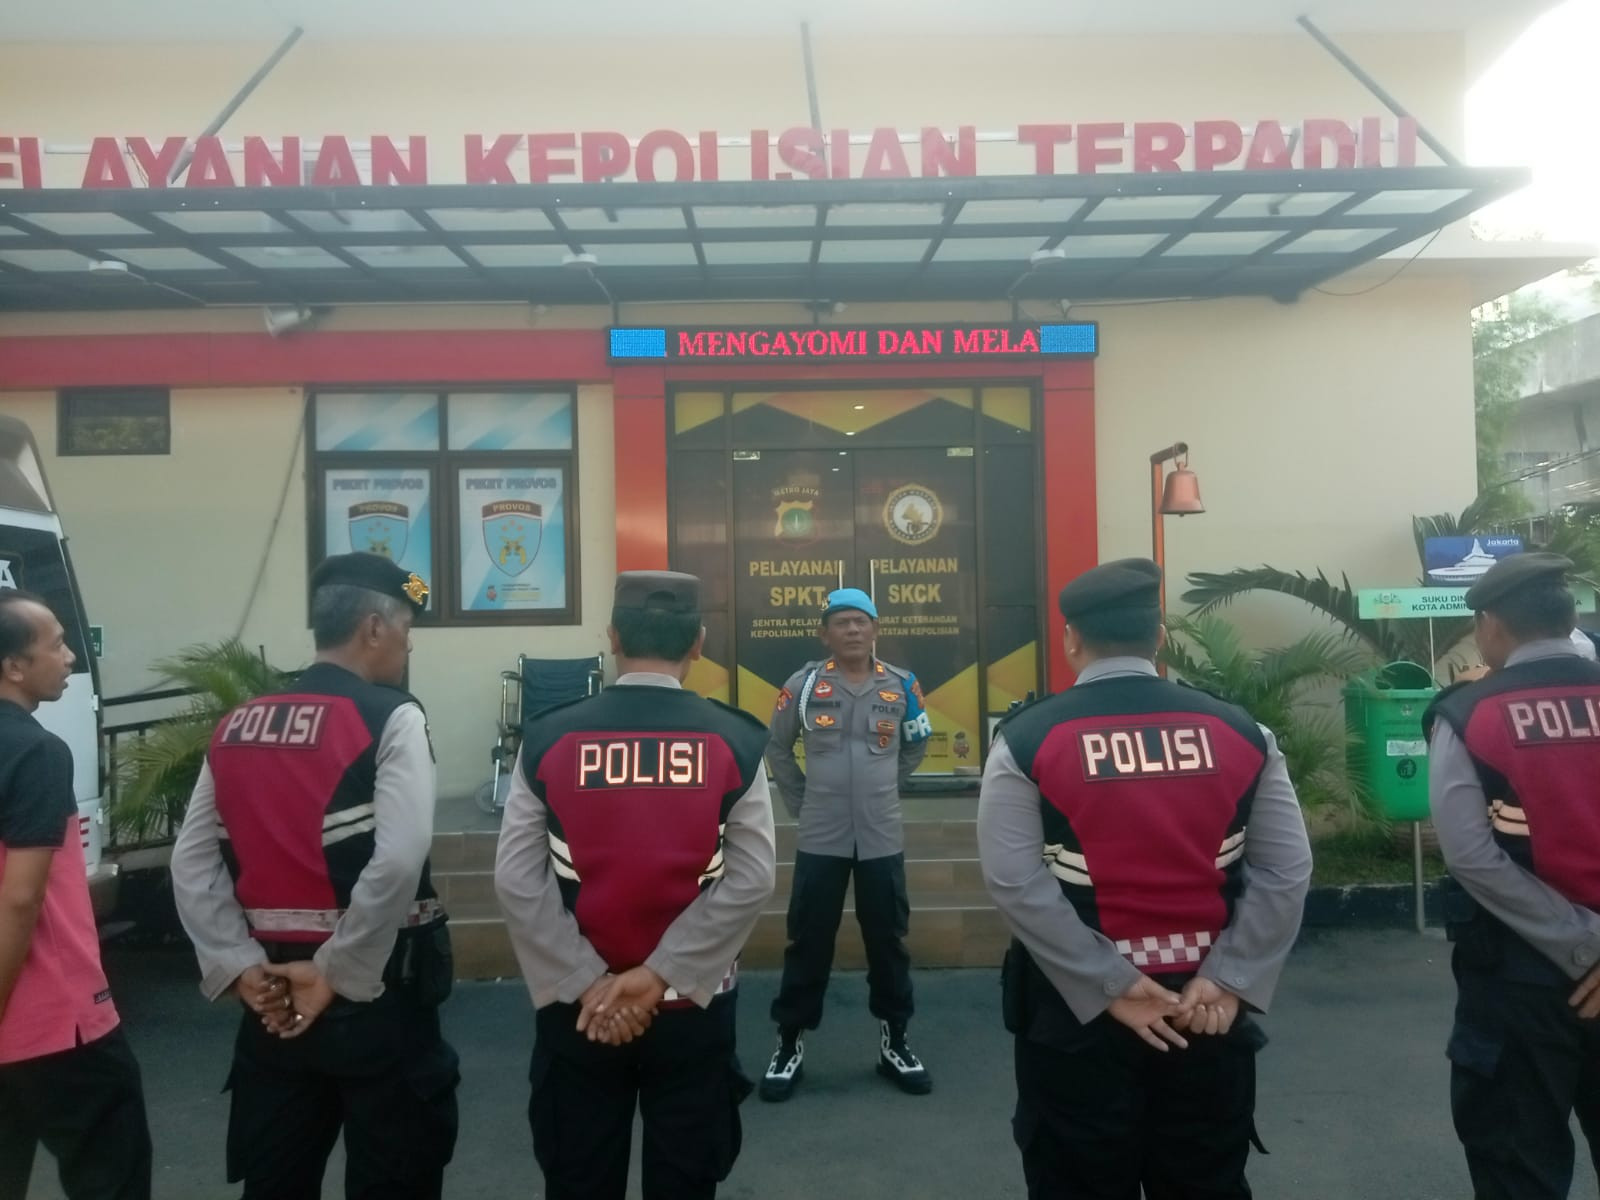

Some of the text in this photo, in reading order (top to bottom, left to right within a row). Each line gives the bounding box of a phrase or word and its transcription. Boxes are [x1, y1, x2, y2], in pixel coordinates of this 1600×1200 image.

[678, 328, 1041, 356] MENGAYOMI DAN MELA
[492, 502, 532, 513] PROVOS
[1487, 538, 1519, 546] Jakarta
[770, 585, 826, 607] SPKT
[888, 583, 942, 604] SKCK
[1421, 594, 1465, 604] SUKU DIN
[1411, 602, 1466, 612] KOTA ADMIN
[752, 617, 822, 628] SENTRA PELAYA
[878, 616, 900, 625] URAT
[751, 629, 804, 639] KEPOLISIAN
[877, 627, 908, 636] ATATAN
[221, 704, 324, 745] POLISI
[902, 711, 932, 741] PR
[1508, 698, 1600, 740] POLI
[1082, 728, 1214, 776] POLISI
[579, 741, 704, 786] POLISI
